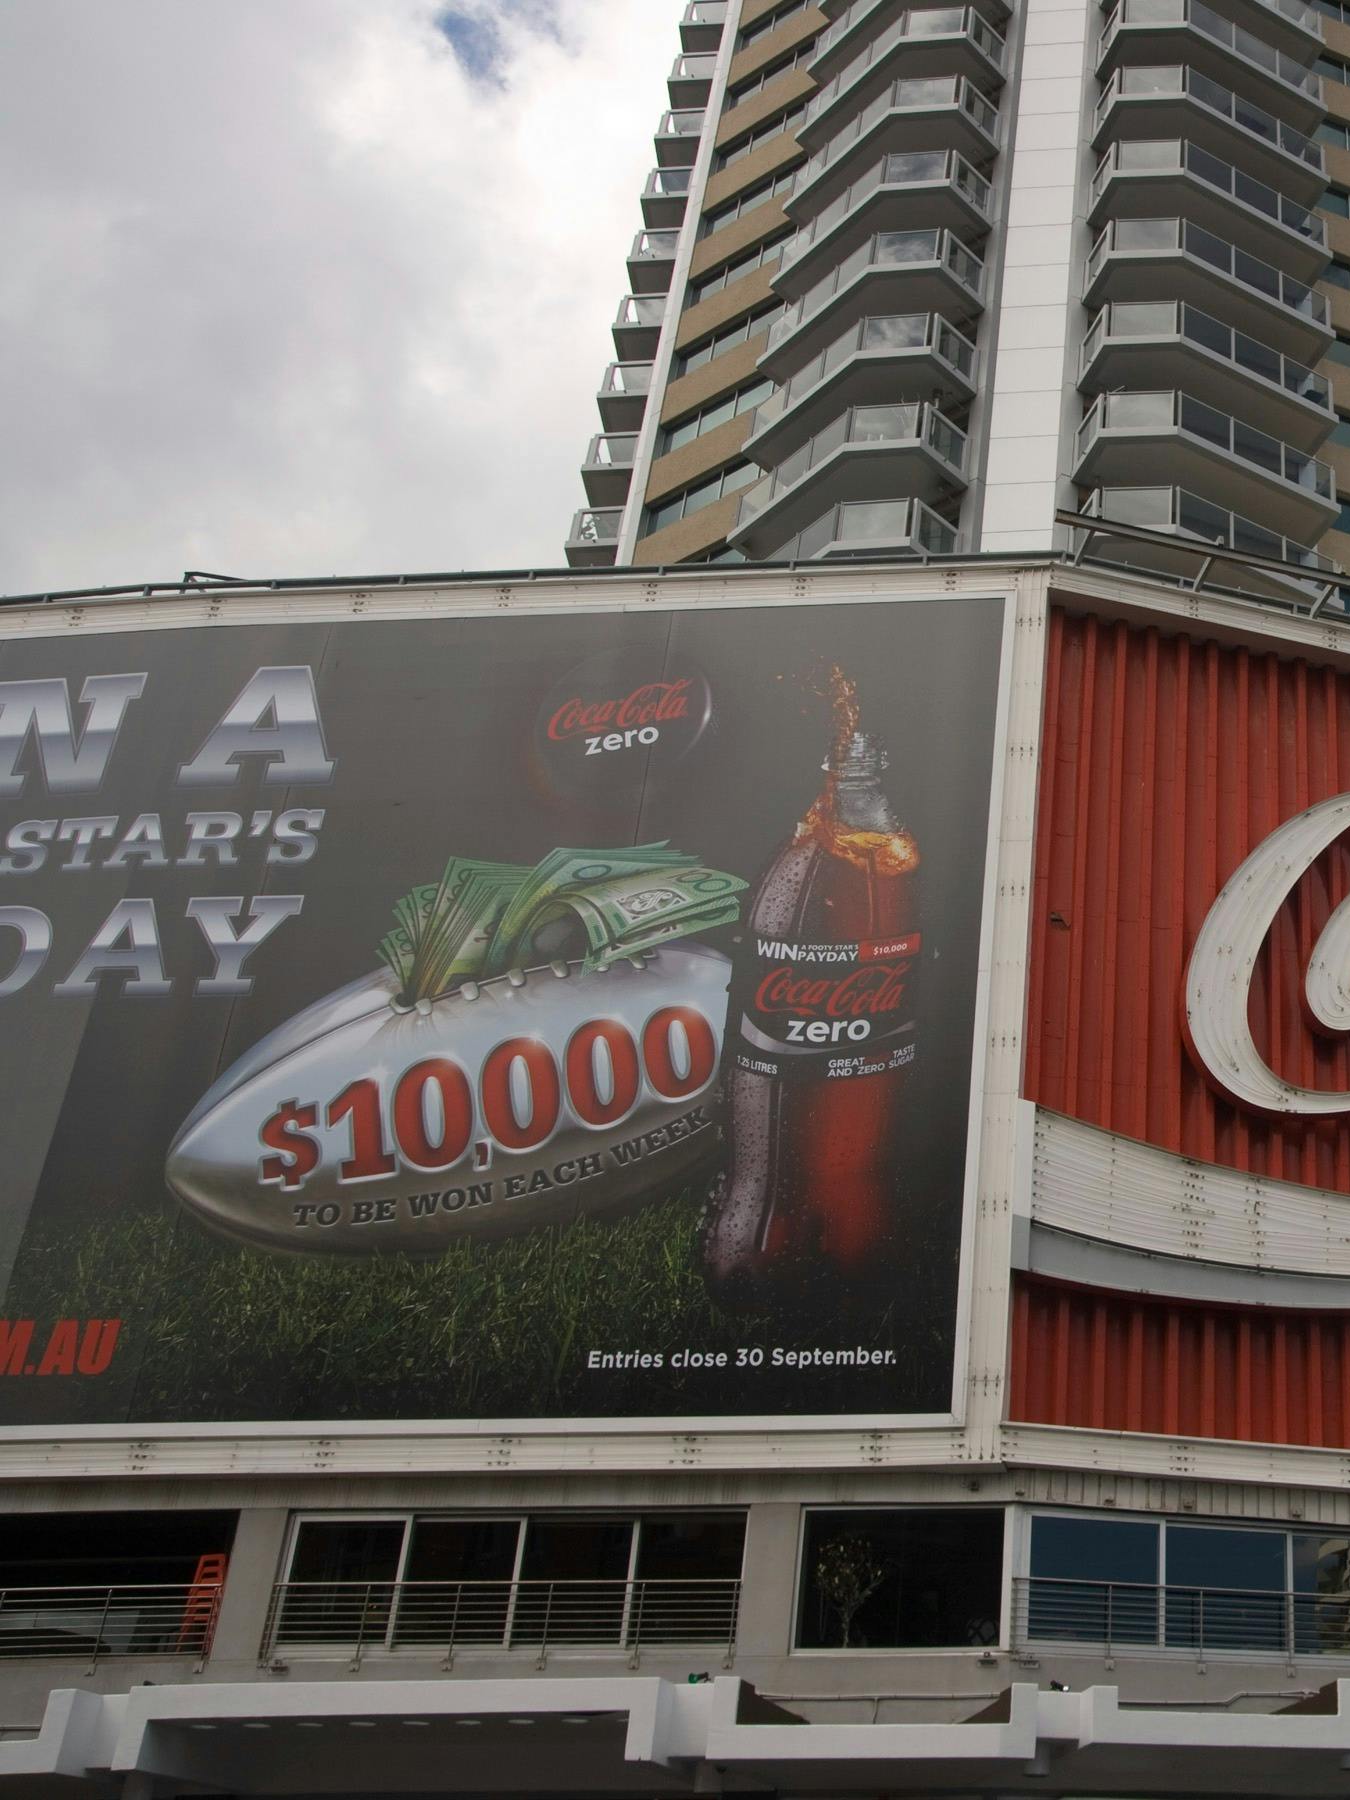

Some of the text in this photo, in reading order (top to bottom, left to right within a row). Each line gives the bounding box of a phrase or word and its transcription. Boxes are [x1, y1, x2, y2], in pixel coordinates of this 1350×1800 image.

[548, 679, 691, 740] Coca-Cola
[174, 664, 338, 788] A
[585, 726, 659, 756] zero
[0, 808, 326, 876] STAR'S
[757, 939, 799, 961] WIN
[798, 951, 858, 962] PAYDAY
[755, 961, 911, 1017] Coca-Cola
[786, 1018, 871, 1043] zero
[750, 1060, 777, 1075] LITRES
[827, 1067, 853, 1078] AND
[857, 1062, 885, 1075] ZERO
[888, 1052, 915, 1069] SUGAR
[828, 1057, 865, 1068] GREAT
[257, 1005, 719, 1191] $10,000
[293, 1104, 713, 1227] TO BE WON EACH WEEK
[587, 1346, 897, 1369] Entries close 30 September.
